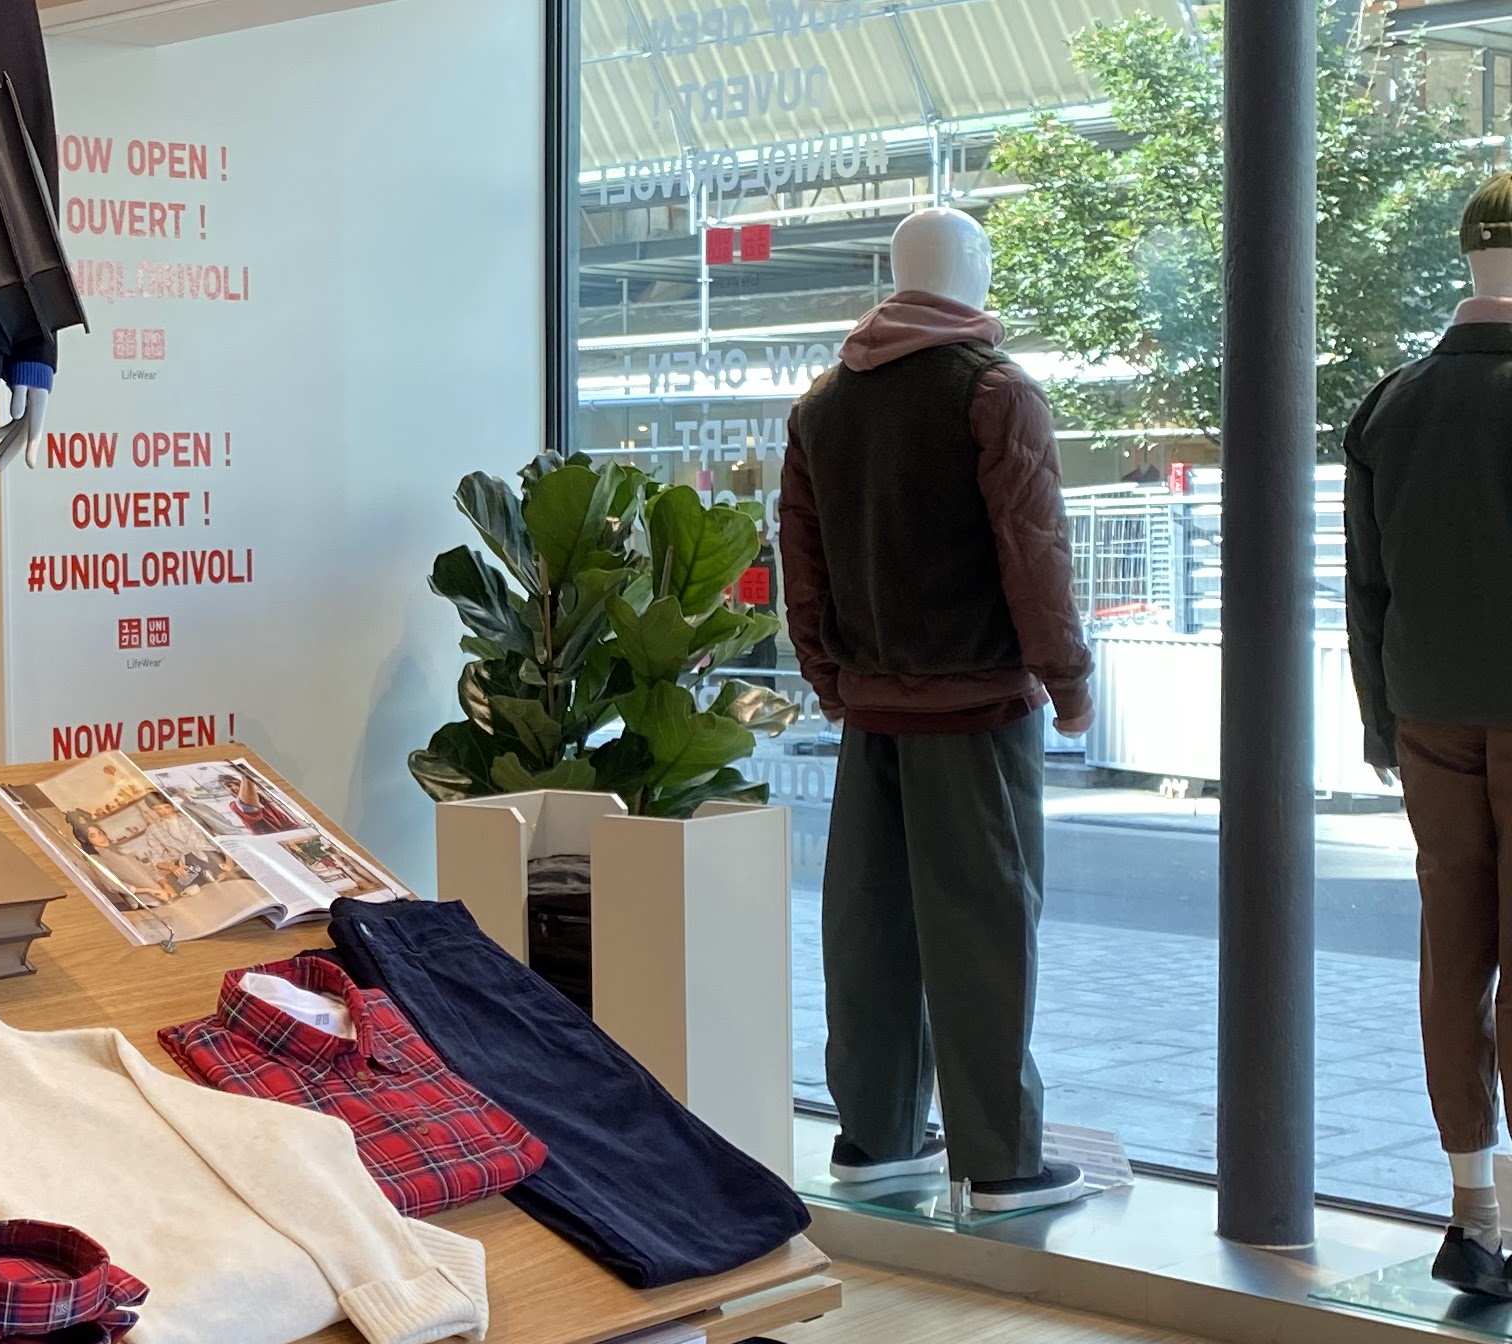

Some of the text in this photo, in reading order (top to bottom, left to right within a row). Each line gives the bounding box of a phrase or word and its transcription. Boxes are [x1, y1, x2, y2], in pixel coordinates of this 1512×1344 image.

[57, 134, 227, 181] OW OPEN !
[67, 197, 206, 240] OUVERT !
[121, 369, 157, 380] LifeWear
[47, 432, 231, 469] NOW OPEN !
[72, 491, 210, 529] OUVERT !
[28, 548, 253, 595] #UNIQLORIVOLI
[127, 658, 162, 670] LifeWear
[52, 722, 123, 761] NOW
[138, 715, 215, 753] OPEN
